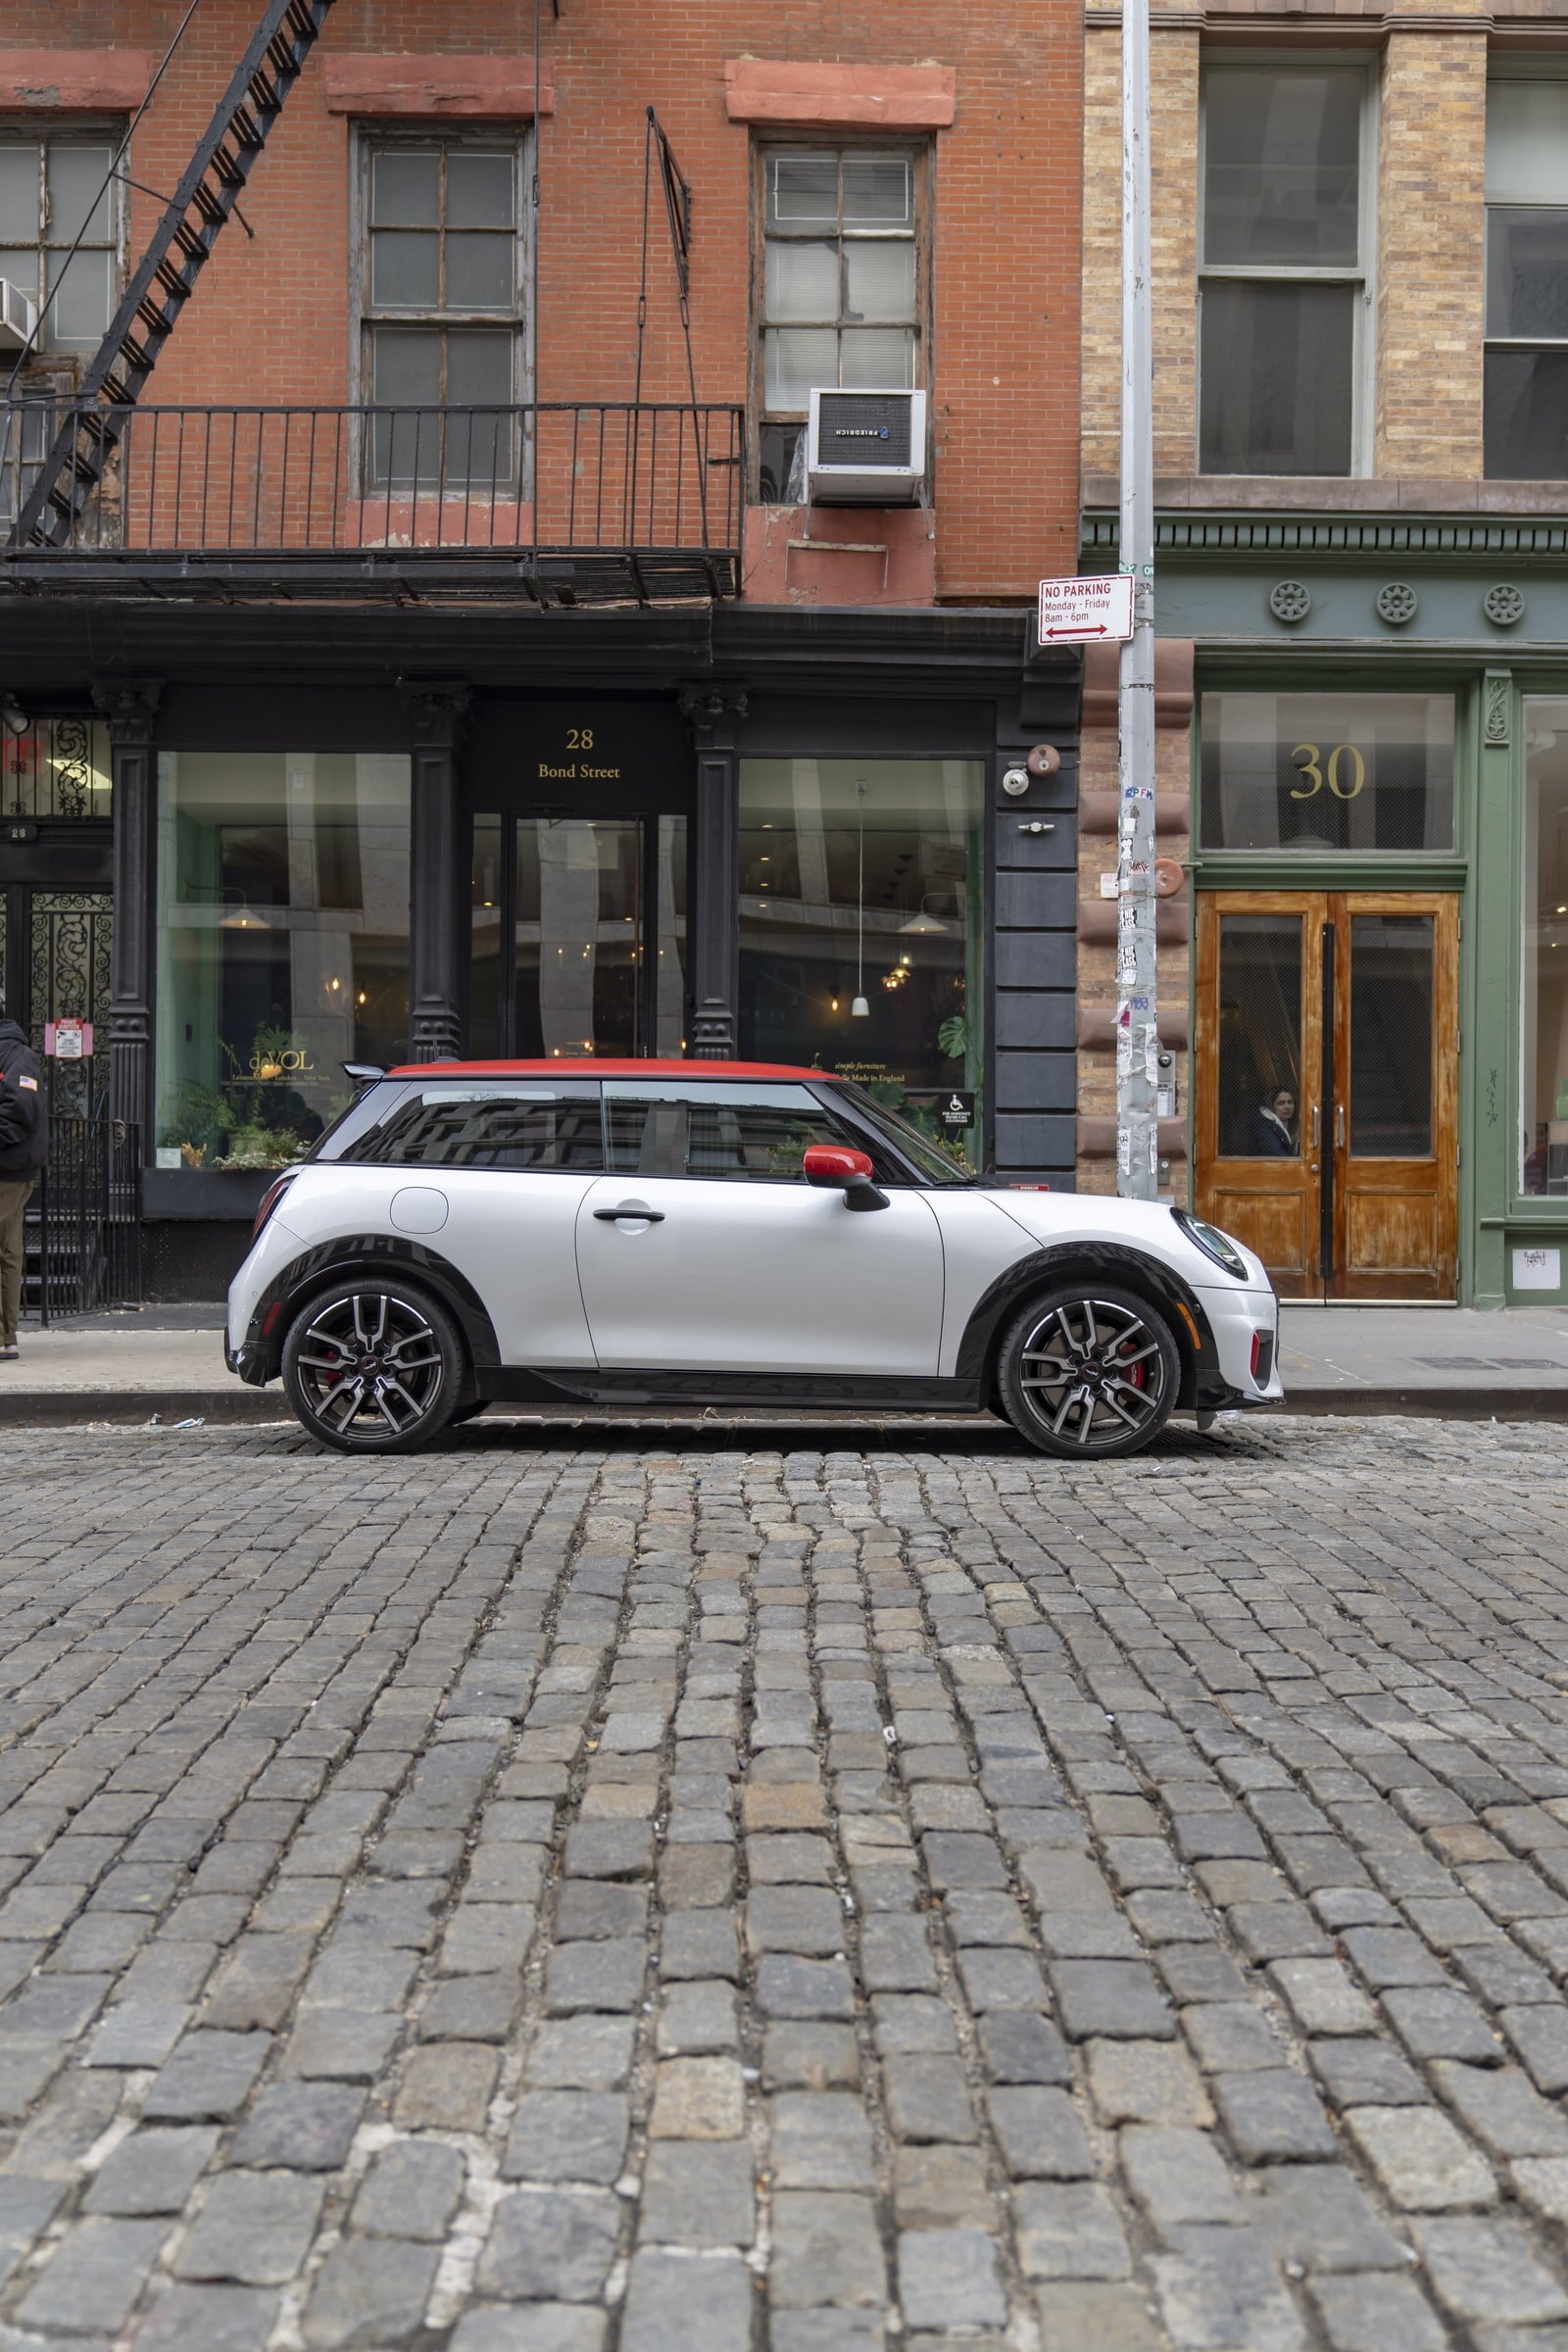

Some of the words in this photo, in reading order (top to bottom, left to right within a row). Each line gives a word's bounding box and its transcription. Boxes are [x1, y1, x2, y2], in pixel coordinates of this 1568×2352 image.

[1045, 586, 1060, 598] NO
[1064, 582, 1111, 597] PARKING
[1045, 601, 1076, 612] Monday
[1085, 599, 1110, 609] Friday
[1045, 612, 1062, 622] 8am
[1070, 612, 1089, 622] 6pm
[565, 729, 594, 749] 28
[538, 763, 576, 778] Bond
[580, 763, 620, 778] Street
[1290, 743, 1364, 799] 30
[11, 828, 26, 838] 28
[834, 1061, 855, 1071] simple
[855, 1061, 886, 1071] furniture
[879, 1074, 906, 1084] England
